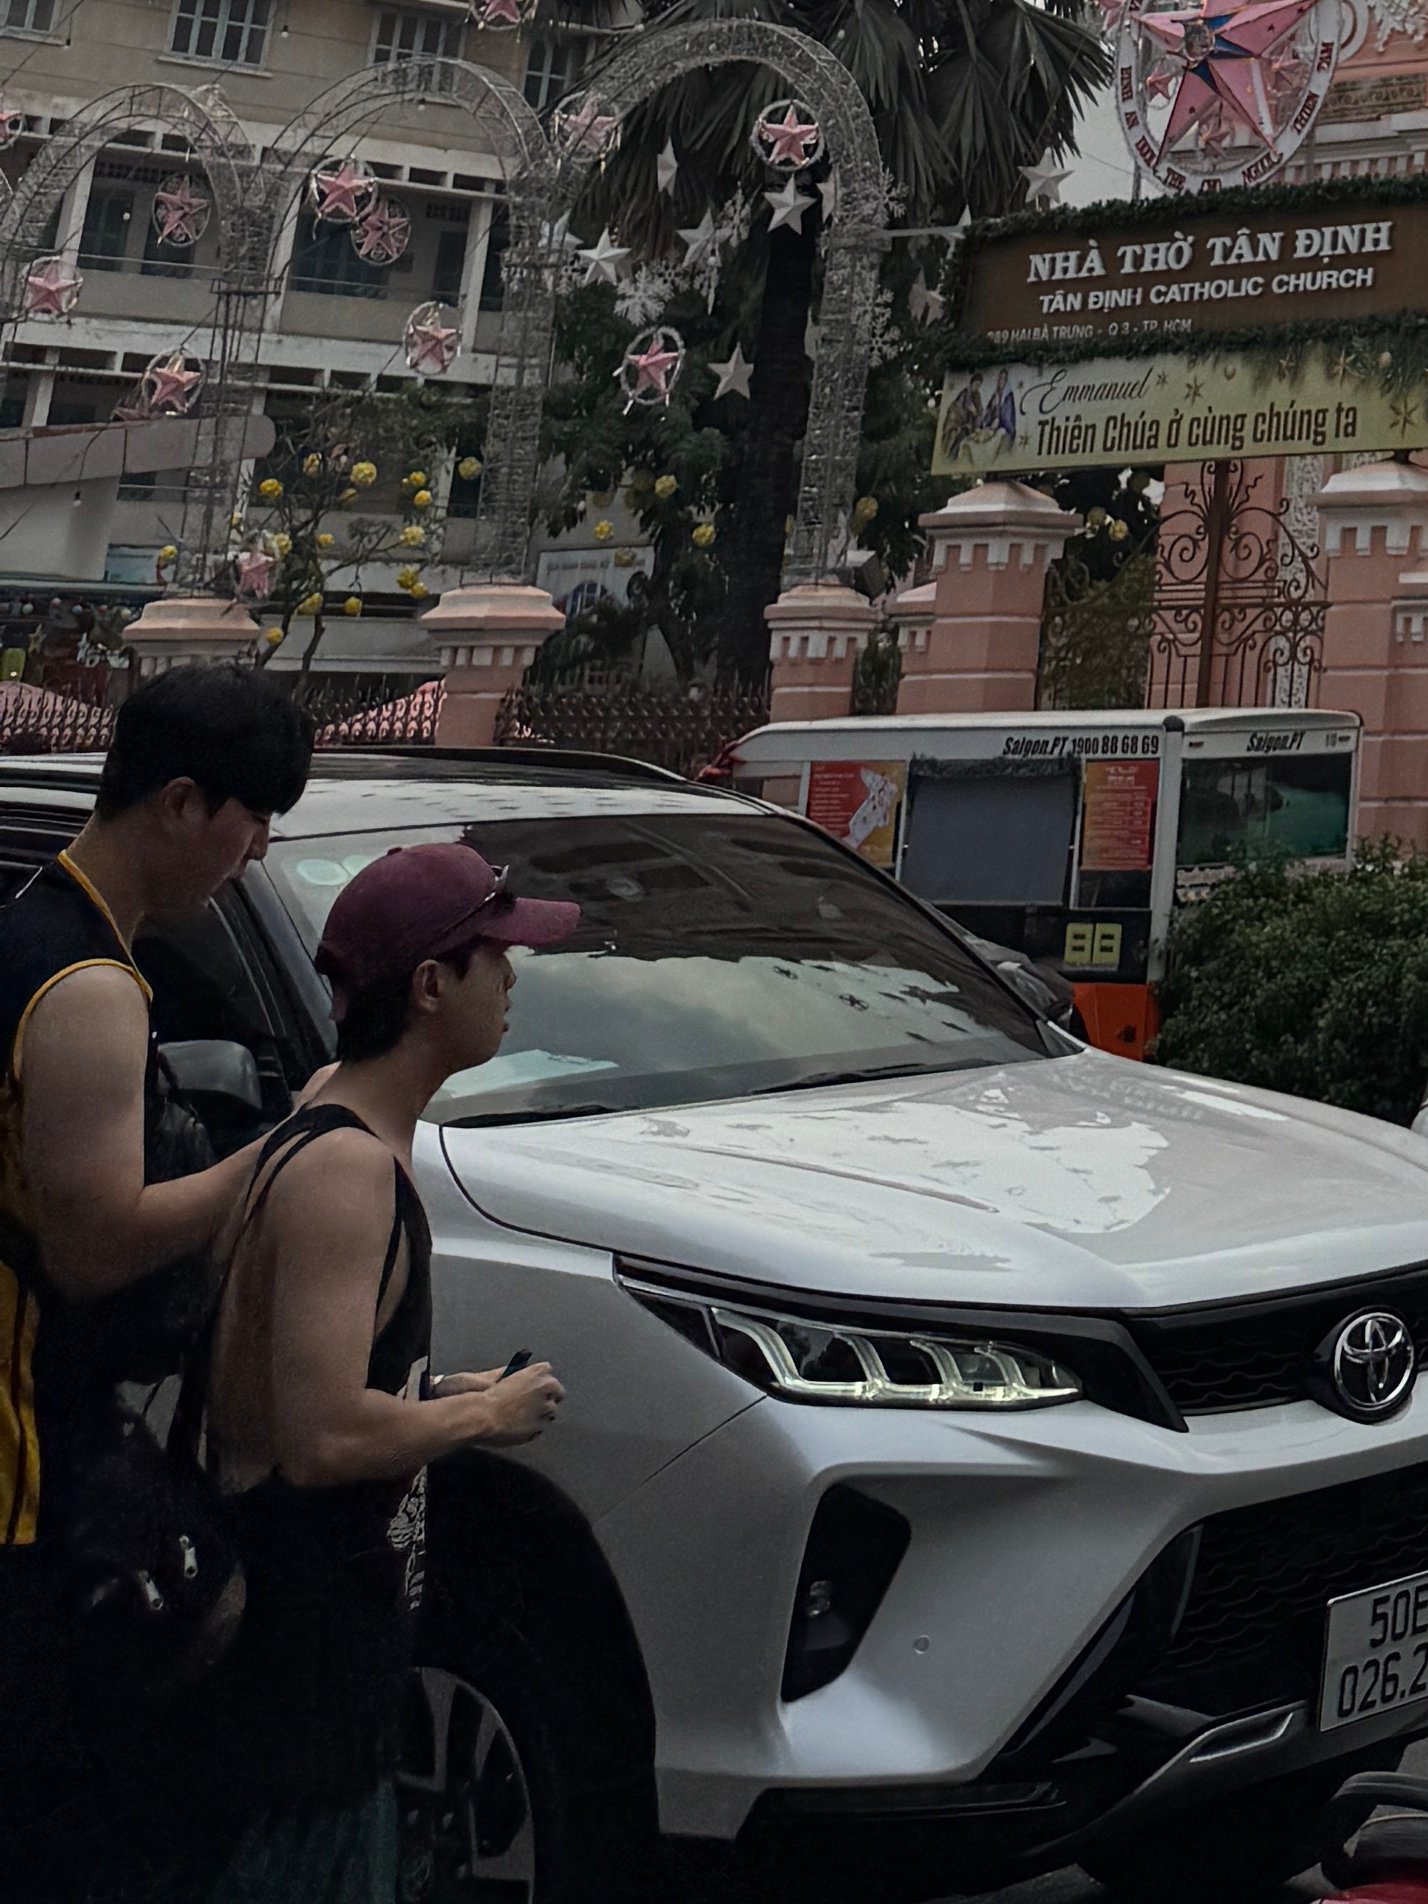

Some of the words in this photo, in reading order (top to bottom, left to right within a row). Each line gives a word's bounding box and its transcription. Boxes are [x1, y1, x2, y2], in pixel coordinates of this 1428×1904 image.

[1026, 239, 1107, 283] NHÀ
[1117, 231, 1195, 274] THỜ
[1206, 227, 1284, 266] TÂN
[1293, 221, 1394, 265] ĐỊNH
[1039, 290, 1082, 313] TÂN
[1088, 287, 1142, 313] ĐỊNH
[1150, 276, 1263, 305] CATHOLIC
[1271, 268, 1374, 293] CHURCH
[1121, 322, 1130, 335] 3
[1163, 318, 1192, 333] HCM
[1019, 367, 1154, 416] Emmanuel
[1037, 414, 1097, 456] Thiên
[1103, 410, 1160, 452] Chúa
[1166, 408, 1185, 449] ở
[1187, 406, 1247, 451] cùng
[1253, 400, 1330, 444] chúng
[1335, 401, 1358, 439] ta
[1071, 737, 1099, 754] 1900
[1101, 735, 1118, 754] 88
[1121, 735, 1139, 754] 68
[1141, 735, 1160, 754] 69
